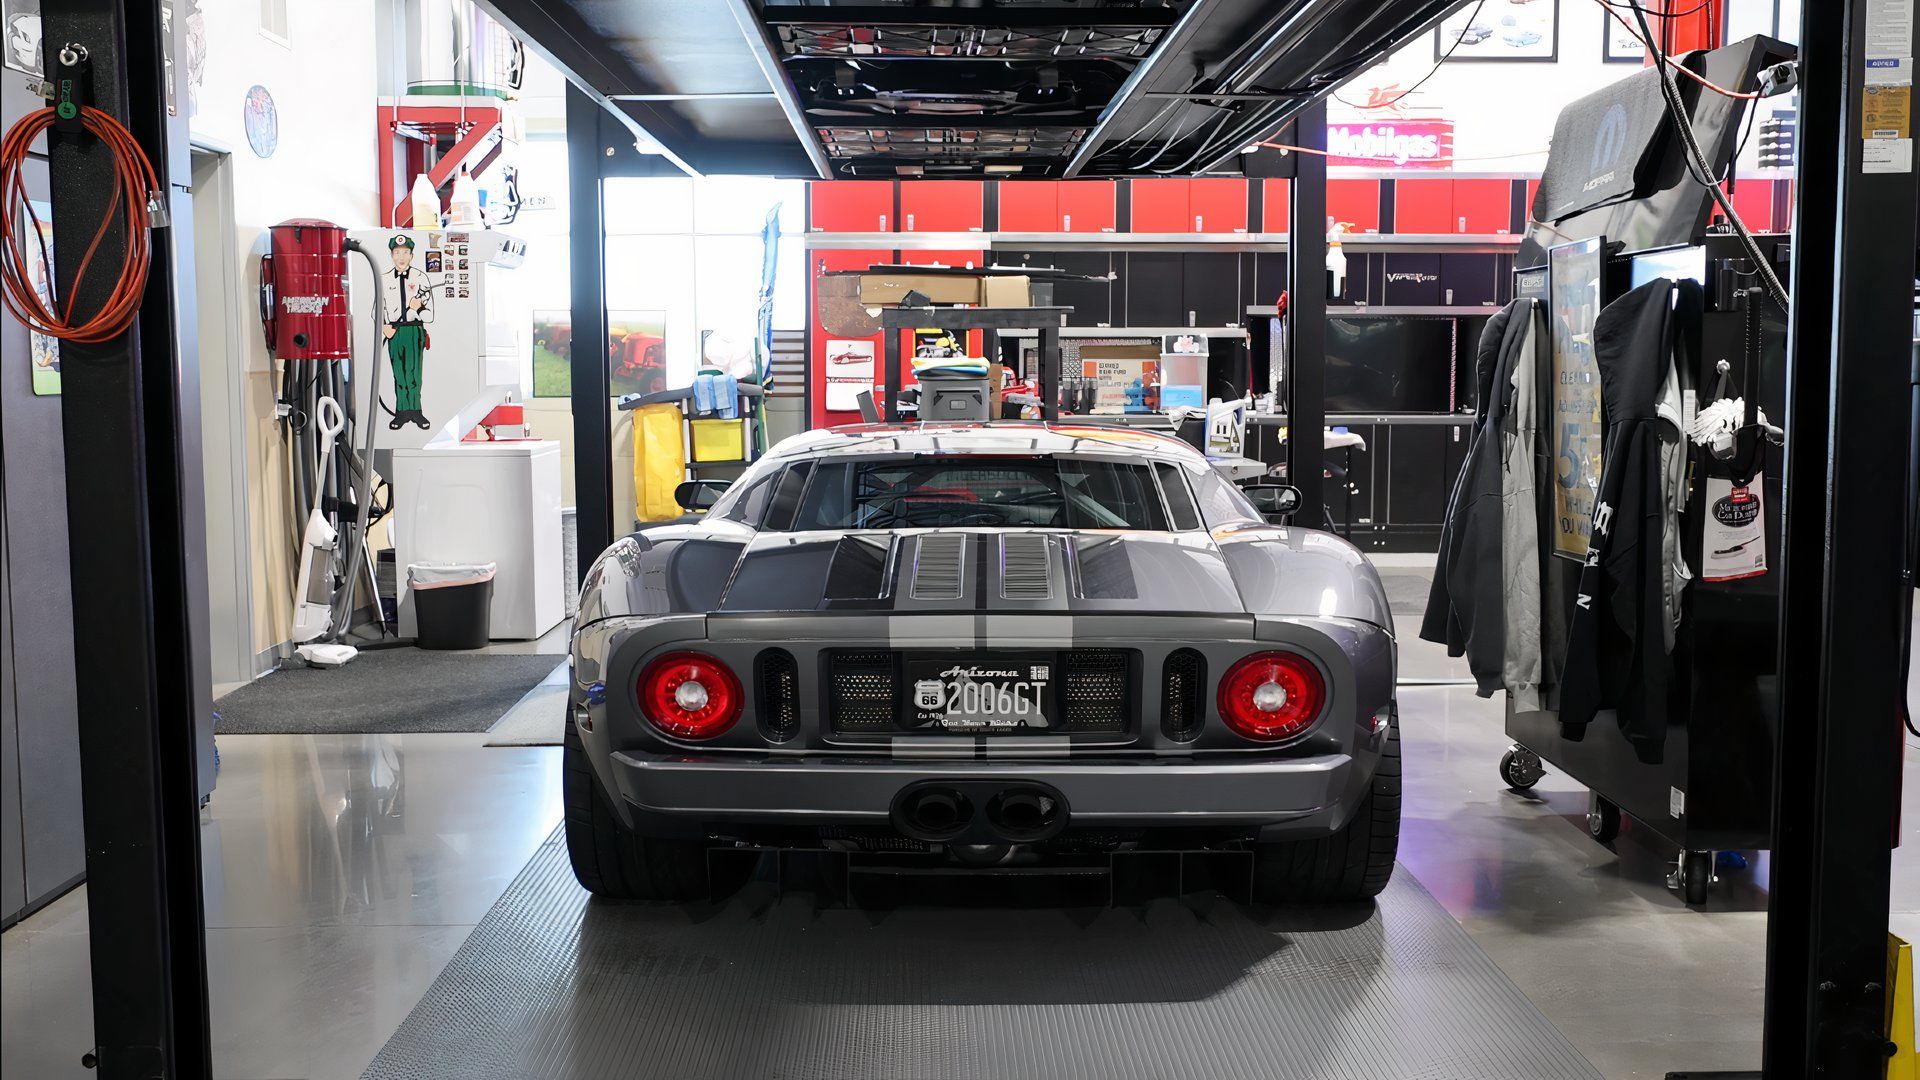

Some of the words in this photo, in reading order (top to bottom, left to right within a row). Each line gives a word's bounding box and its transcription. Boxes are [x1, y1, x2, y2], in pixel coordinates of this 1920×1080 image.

[1328, 126, 1438, 165] Mobilgas
[940, 665, 1019, 678] Arizona
[922, 695, 938, 706] 66
[947, 681, 1046, 715] 2006GT
